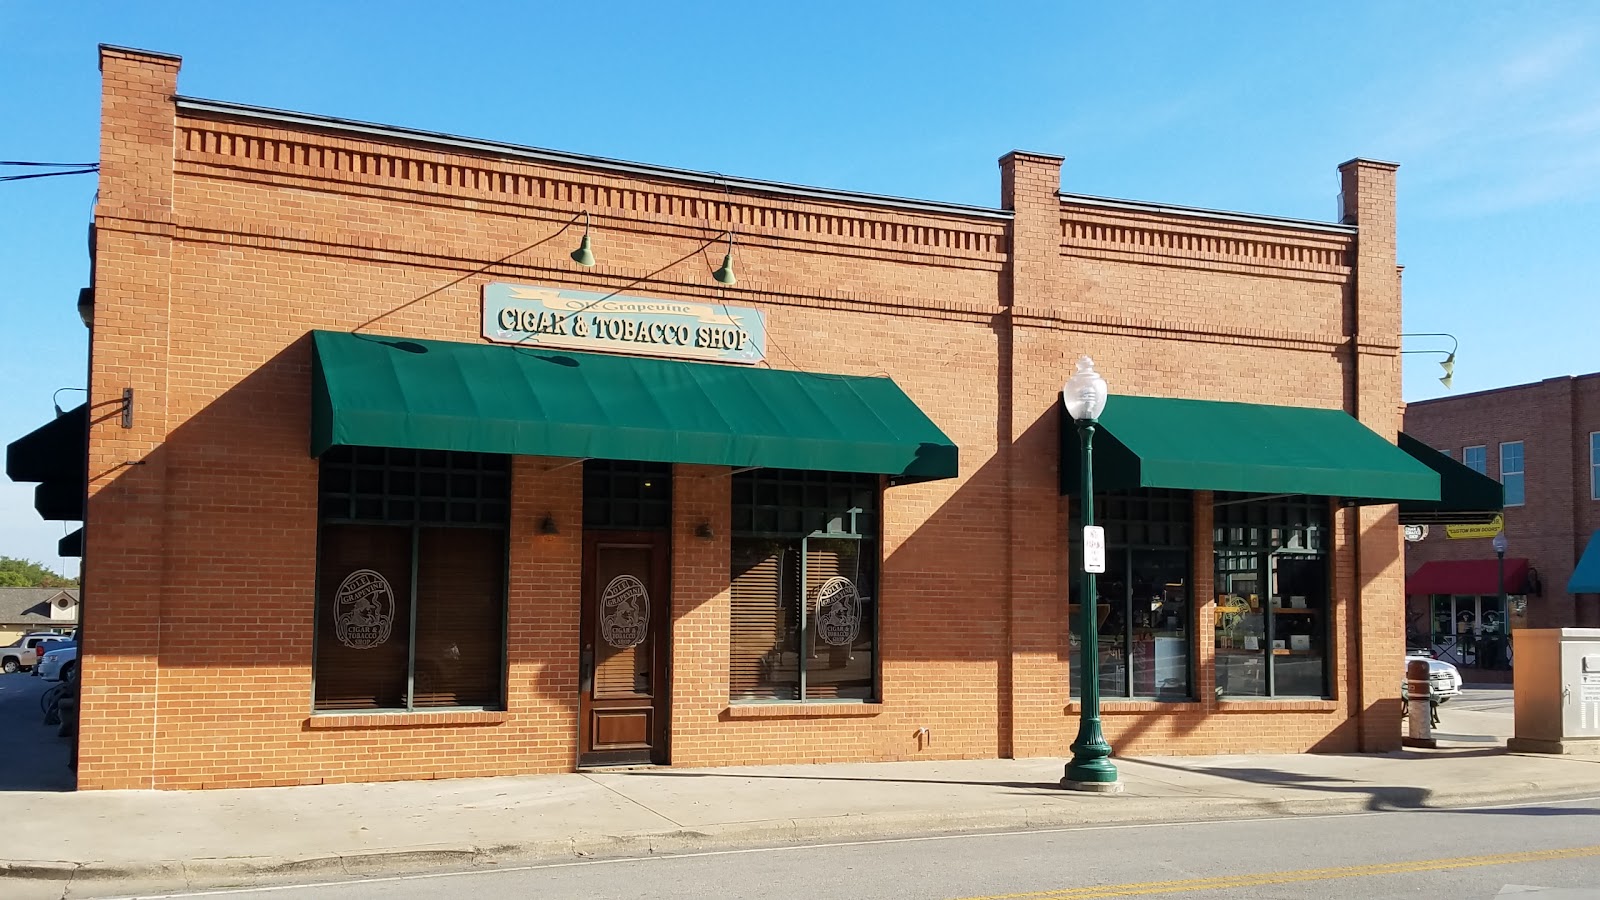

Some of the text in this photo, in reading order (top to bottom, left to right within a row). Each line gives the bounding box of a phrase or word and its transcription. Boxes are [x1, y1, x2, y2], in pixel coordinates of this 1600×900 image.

[602, 302, 691, 314] Grapevine
[498, 306, 749, 351] CIGAR & TOBACCO SHOP
[349, 577, 367, 591] OLE
[612, 583, 626, 594] OLE
[828, 584, 840, 595] OLE
[343, 582, 383, 602] GRAPEVINE
